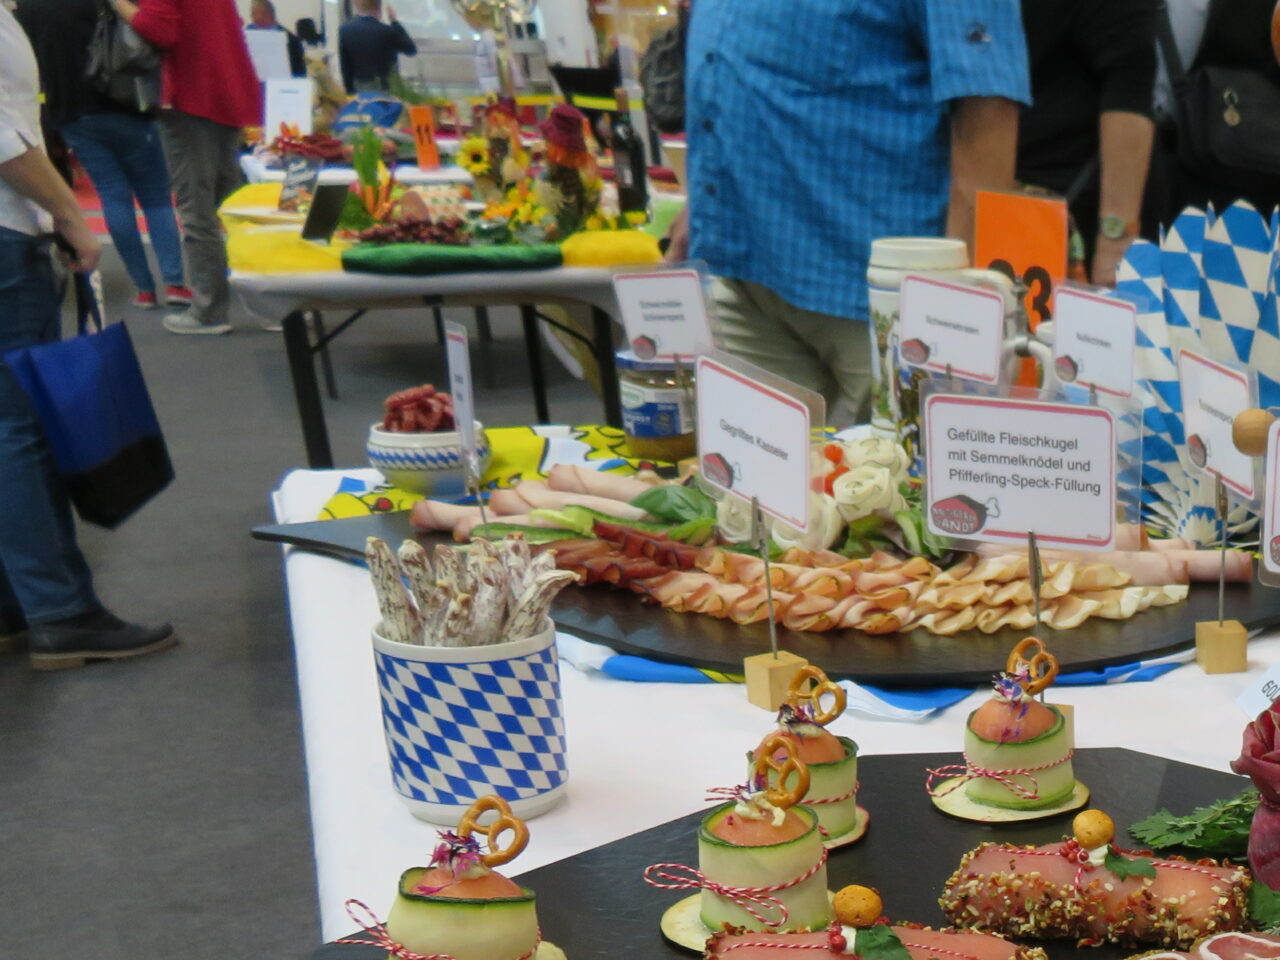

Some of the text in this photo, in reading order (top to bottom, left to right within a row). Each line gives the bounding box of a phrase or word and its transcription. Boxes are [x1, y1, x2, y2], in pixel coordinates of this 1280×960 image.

[988, 259, 1051, 336] 3
[947, 427, 1078, 452] Gefüllte Fleischkugel
[948, 450, 1091, 472] mit Semmelknödel und
[949, 468, 1101, 496] Pfifferling-Speck-Füllung
